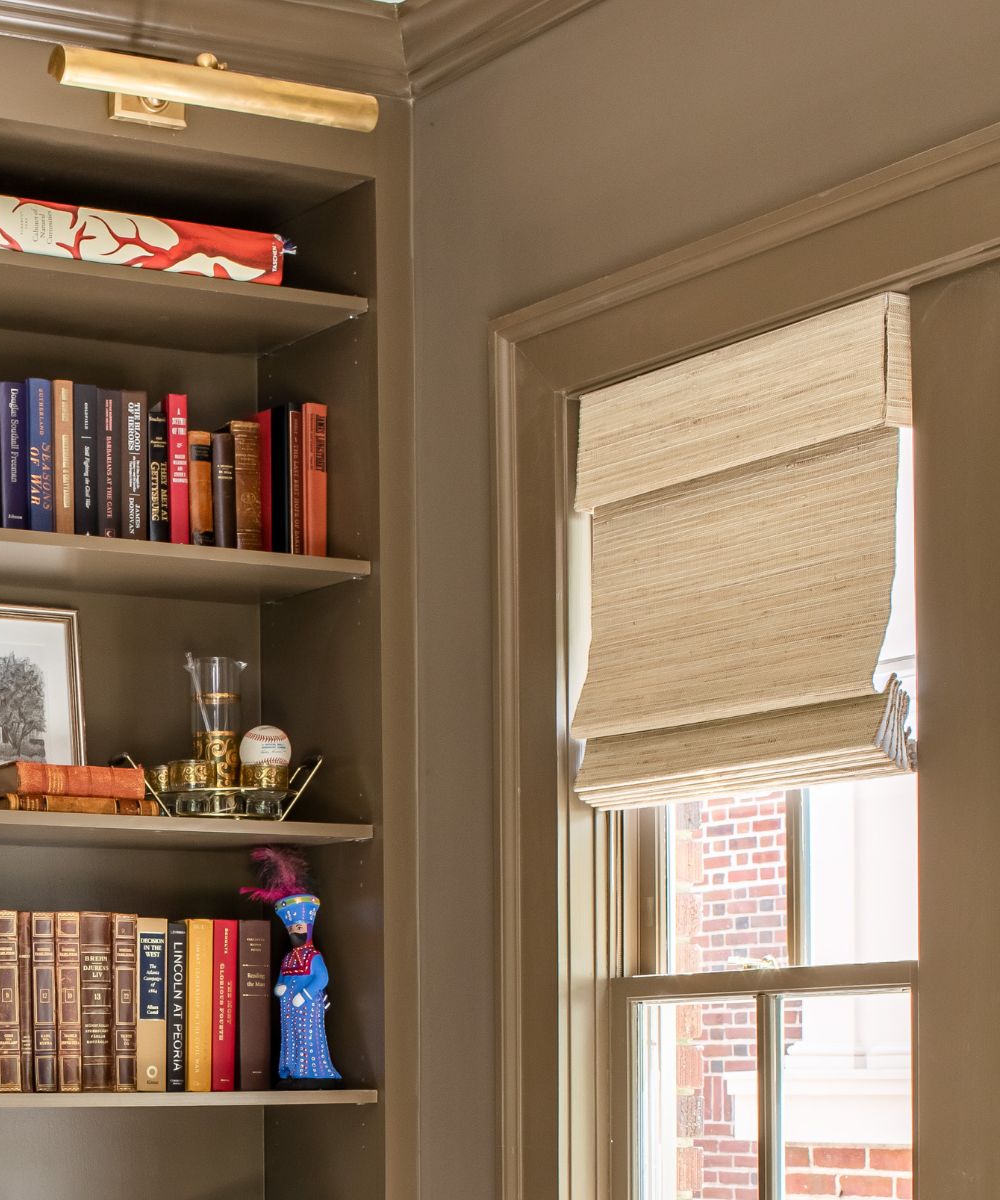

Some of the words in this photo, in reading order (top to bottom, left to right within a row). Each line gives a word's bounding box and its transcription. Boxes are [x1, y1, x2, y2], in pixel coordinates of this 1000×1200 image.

[9, 388, 19, 418] Douglas
[127, 402, 135, 415] OF
[10, 419, 19, 450] Southall
[127, 415, 135, 451] HEROES
[10, 451, 19, 483] Freeman
[30, 446, 40, 466] OF
[83, 457, 91, 476] Fighting
[41, 442, 52, 511] SEASONS
[106, 476, 113, 485] AT
[160, 462, 168, 486] THEY
[30, 474, 42, 505] WAR
[150, 461, 160, 521] GETTYSBURG
[160, 488, 168, 509] MET
[161, 509, 169, 522] AT
[173, 942, 183, 999] LINCOLN
[247, 972, 266, 980] Reading
[94, 993, 102, 1001] 13
[173, 1003, 183, 1020] AT
[172, 1023, 184, 1072] PEORIA
